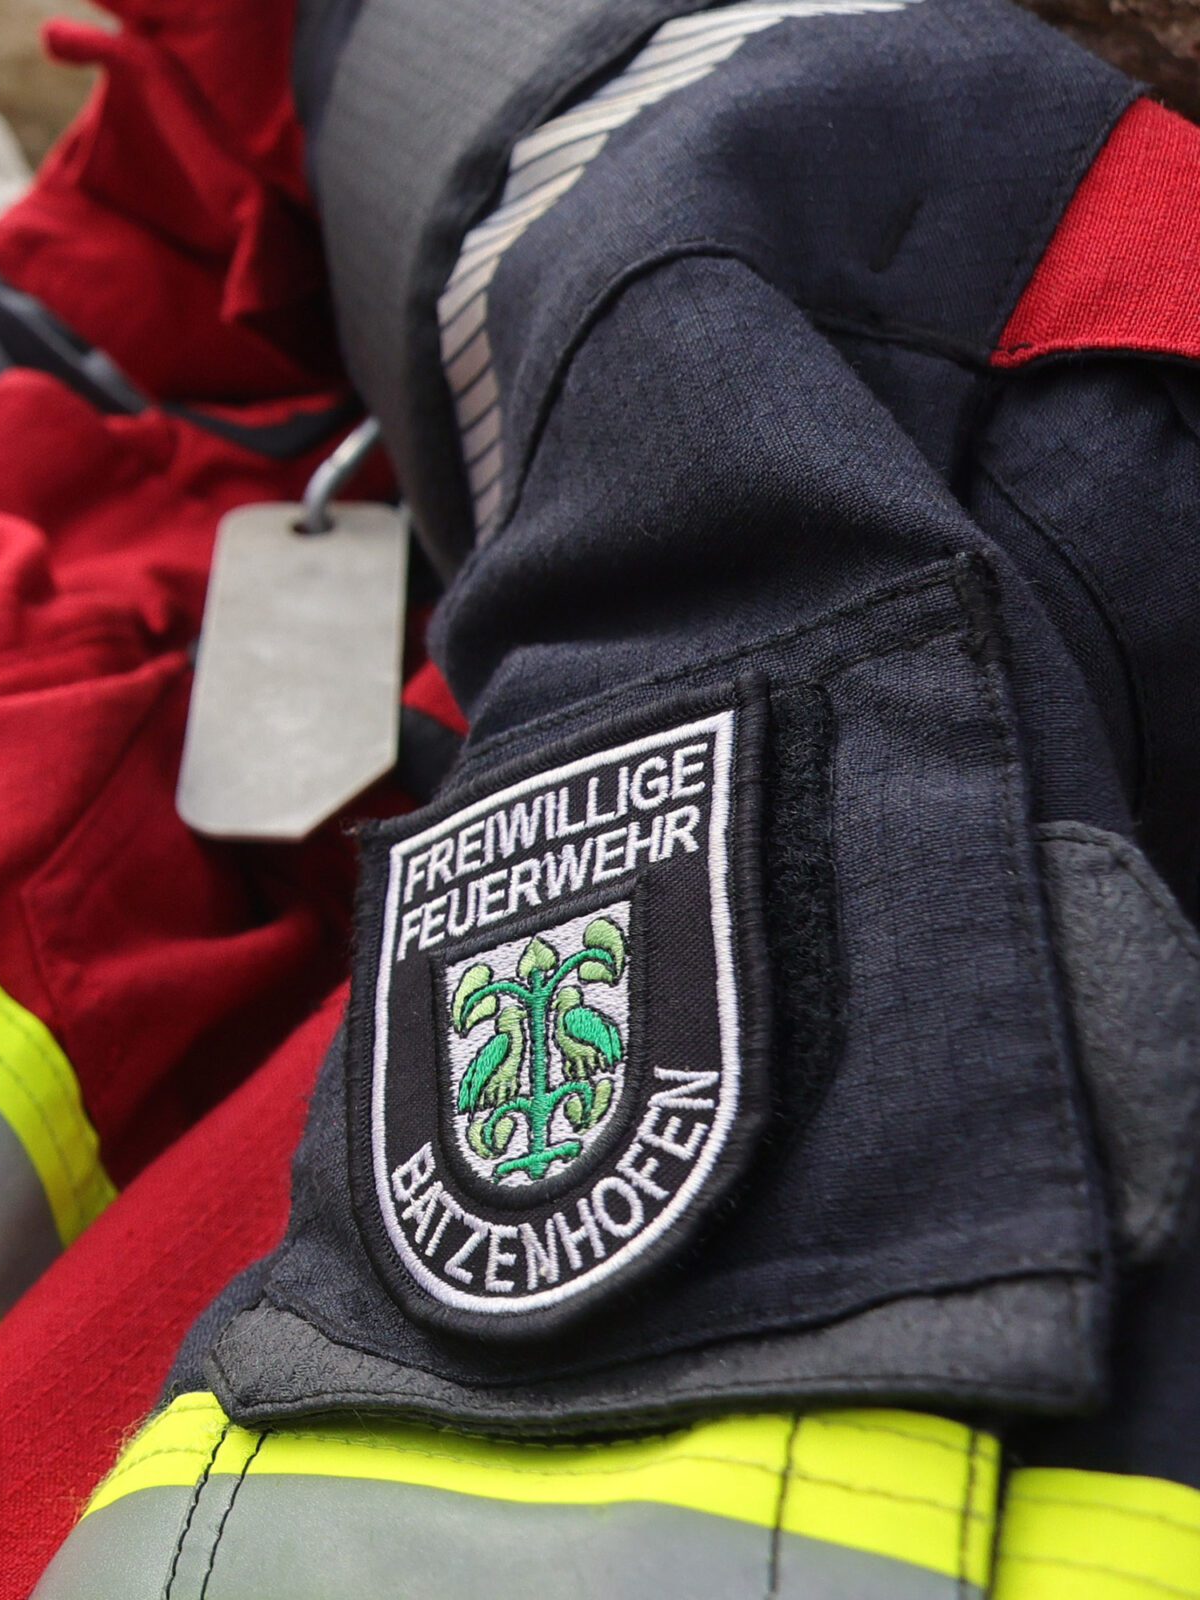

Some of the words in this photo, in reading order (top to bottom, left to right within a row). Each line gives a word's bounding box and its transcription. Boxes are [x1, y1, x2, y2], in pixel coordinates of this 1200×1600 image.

[397, 806, 701, 962] FEUERWEHR
[404, 743, 708, 904] FREIWILLIGE
[392, 1067, 720, 1293] BATZENHOFEN
